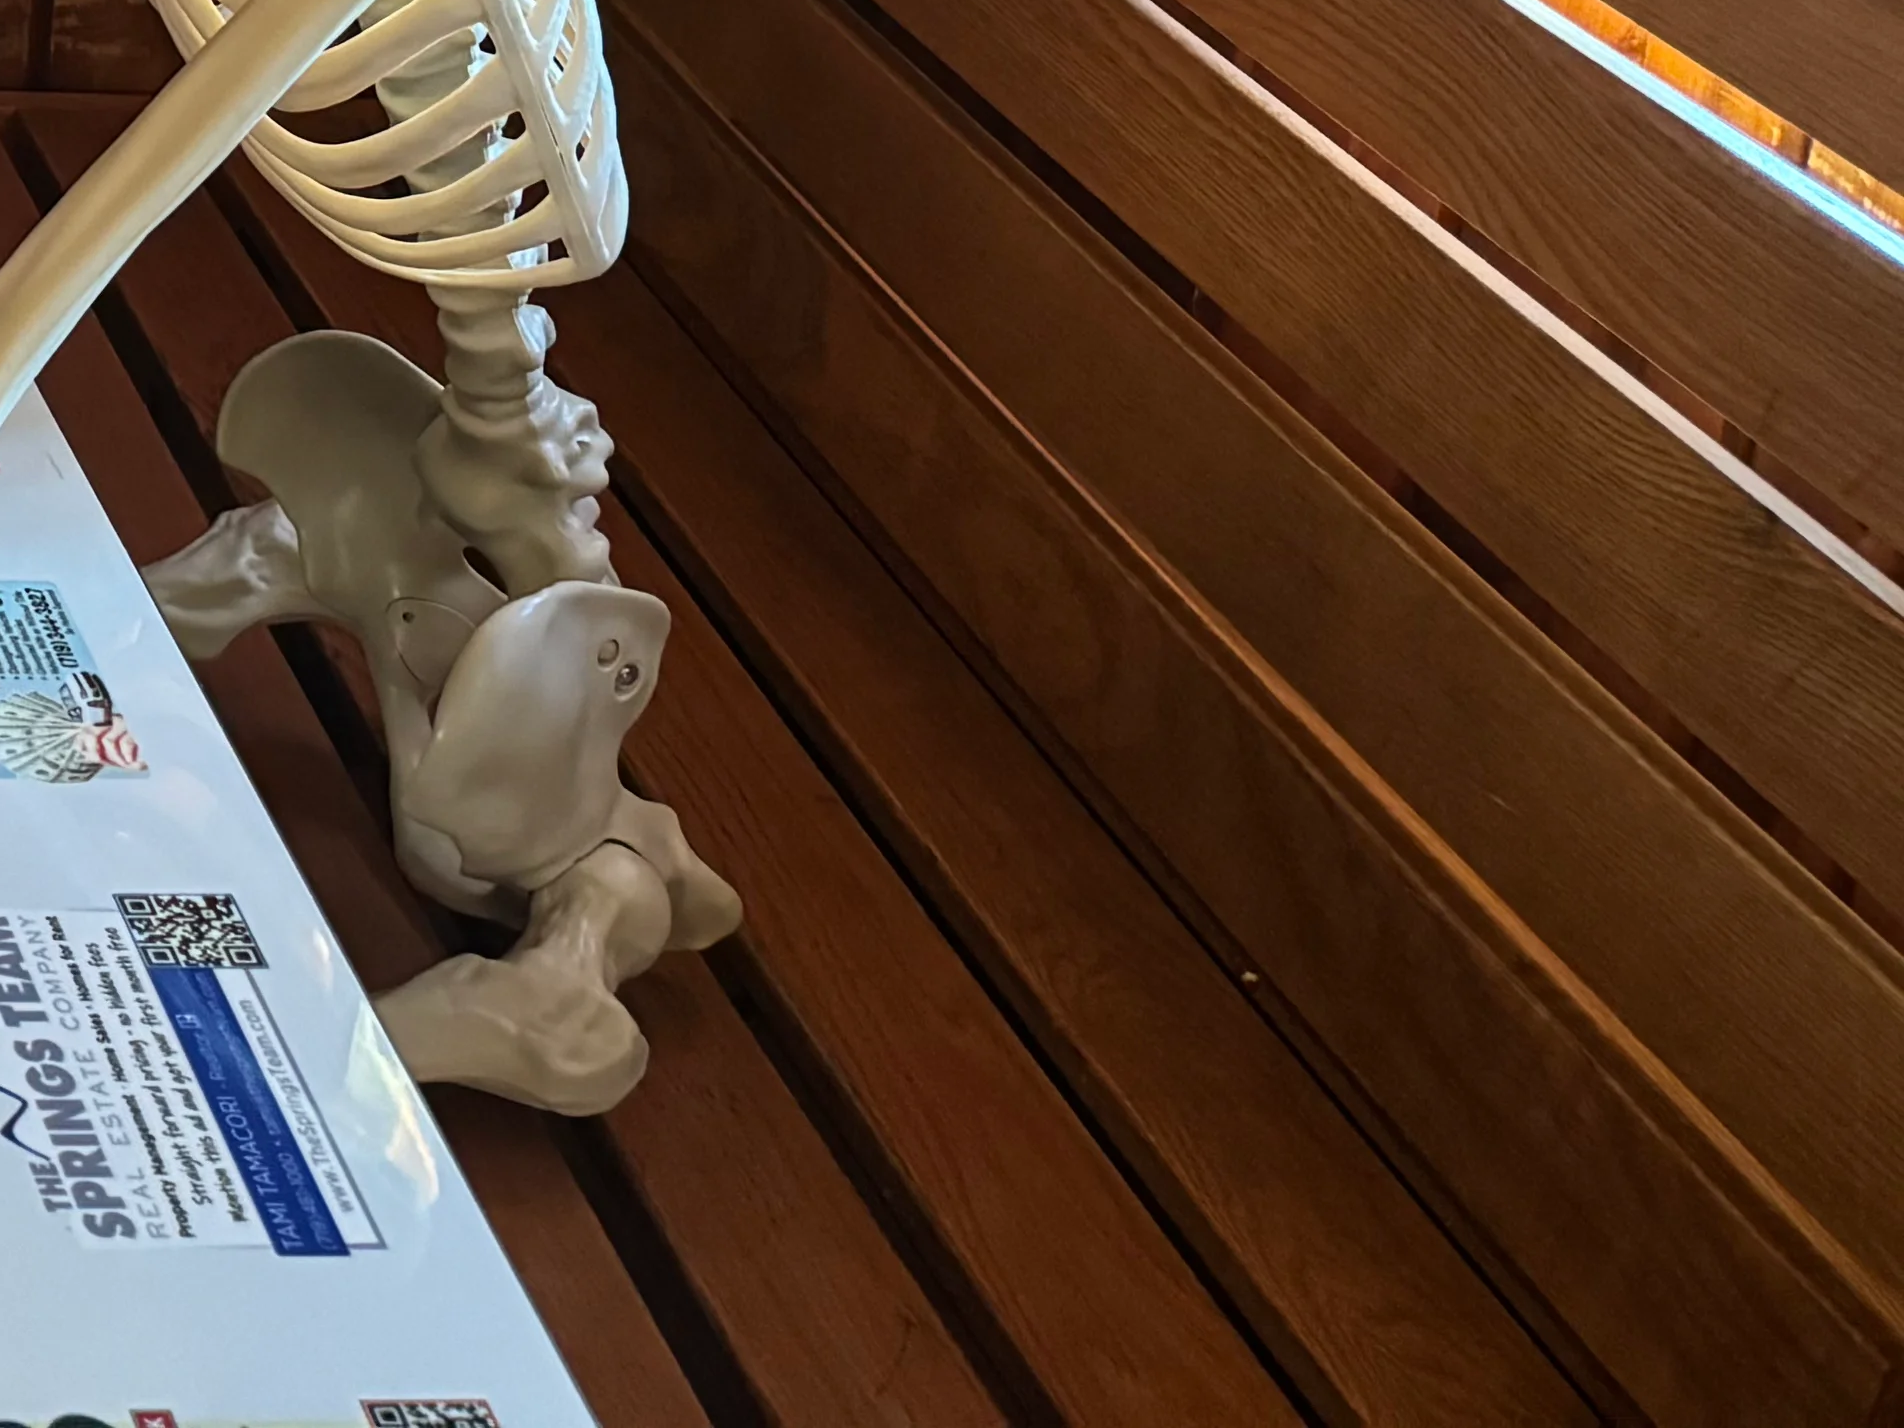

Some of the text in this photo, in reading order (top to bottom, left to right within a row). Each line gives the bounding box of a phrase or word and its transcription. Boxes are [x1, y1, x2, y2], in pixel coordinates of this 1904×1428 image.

[50, 640, 78, 668] (719)
[15, 1040, 134, 1237] SPRINGS
[17, 915, 169, 1239] REAL ESTATE COMPANY
[45, 915, 194, 1238] Property Management Home Sales Homes for Rent
[85, 942, 212, 1205] Straight forward pricing hidden fees
[104, 927, 247, 1222] Mention this and get your first month free
[217, 1095, 277, 1194] TAMACORI
[239, 1000, 352, 1211] www.TheSpringsTeam.com
[28, 1161, 73, 1213] THE
[265, 1202, 303, 1248] TAMI
